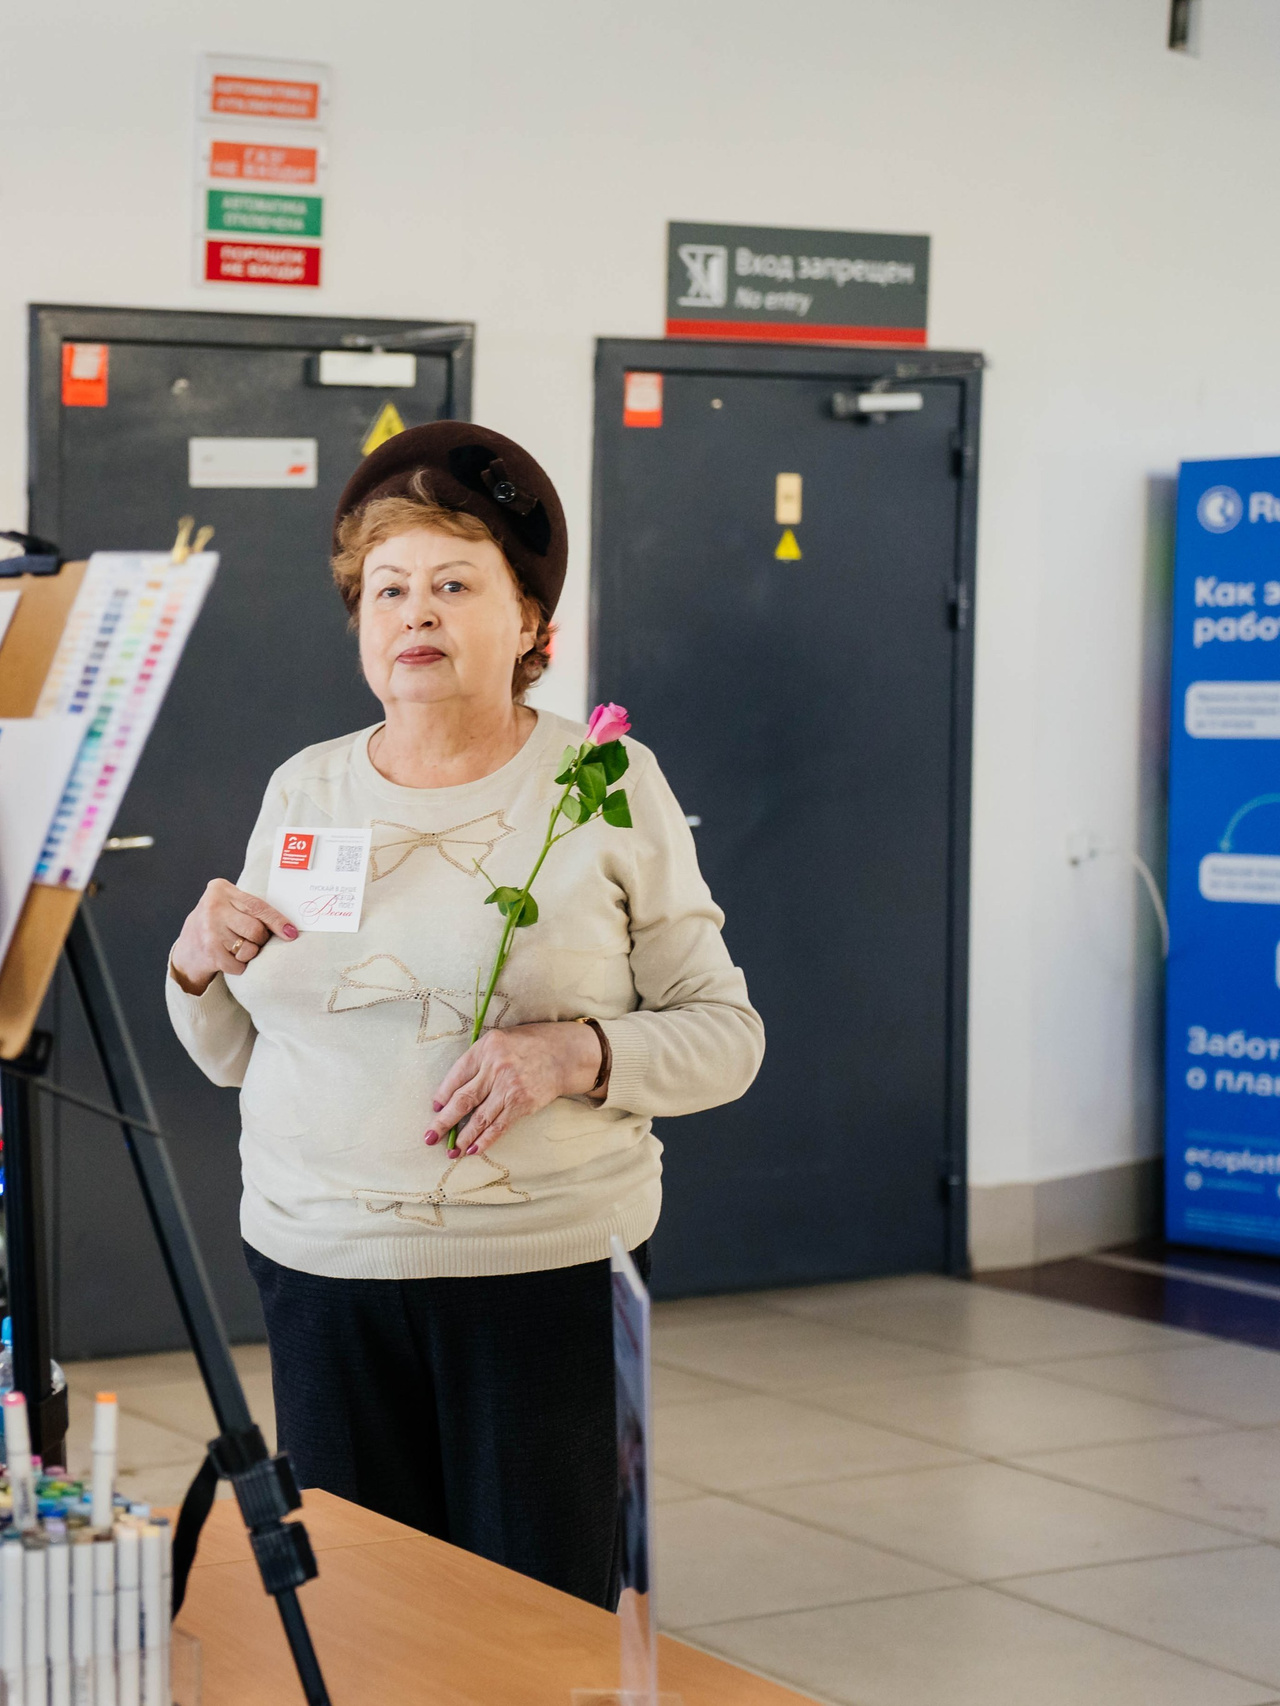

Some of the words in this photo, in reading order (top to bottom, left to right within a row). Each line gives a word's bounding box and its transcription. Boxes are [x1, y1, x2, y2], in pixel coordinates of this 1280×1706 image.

[220, 261, 244, 277] НЕ
[734, 247, 795, 283] Вход
[796, 256, 916, 288] запрещен
[734, 286, 762, 310] No
[763, 291, 814, 317] entry
[1194, 576, 1257, 608] Как
[287, 836, 307, 850] 20
[1186, 1067, 1208, 1090] о
